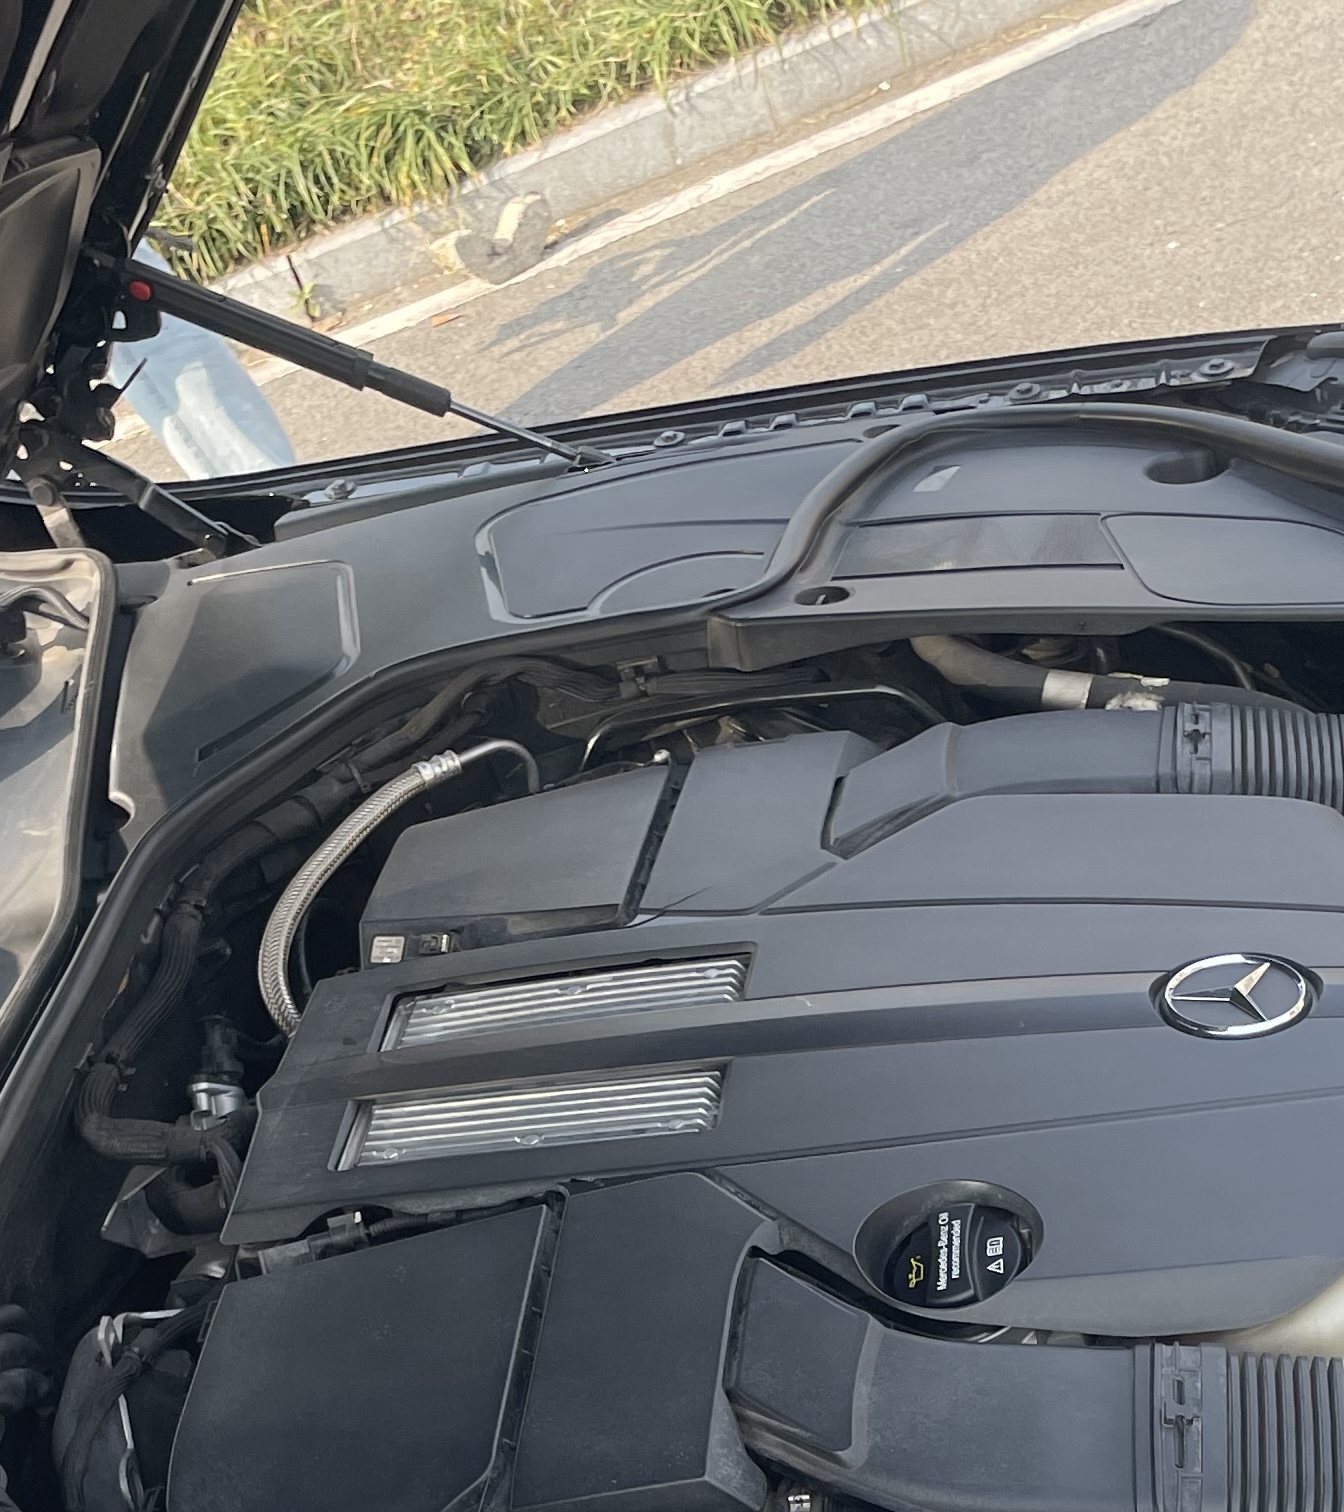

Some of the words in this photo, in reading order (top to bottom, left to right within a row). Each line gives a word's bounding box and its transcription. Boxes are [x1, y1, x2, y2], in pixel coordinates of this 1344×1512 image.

[938, 1211, 949, 1225] Oil
[937, 1225, 948, 1290] Mercedes-Benz
[951, 1220, 960, 1278] recommended
